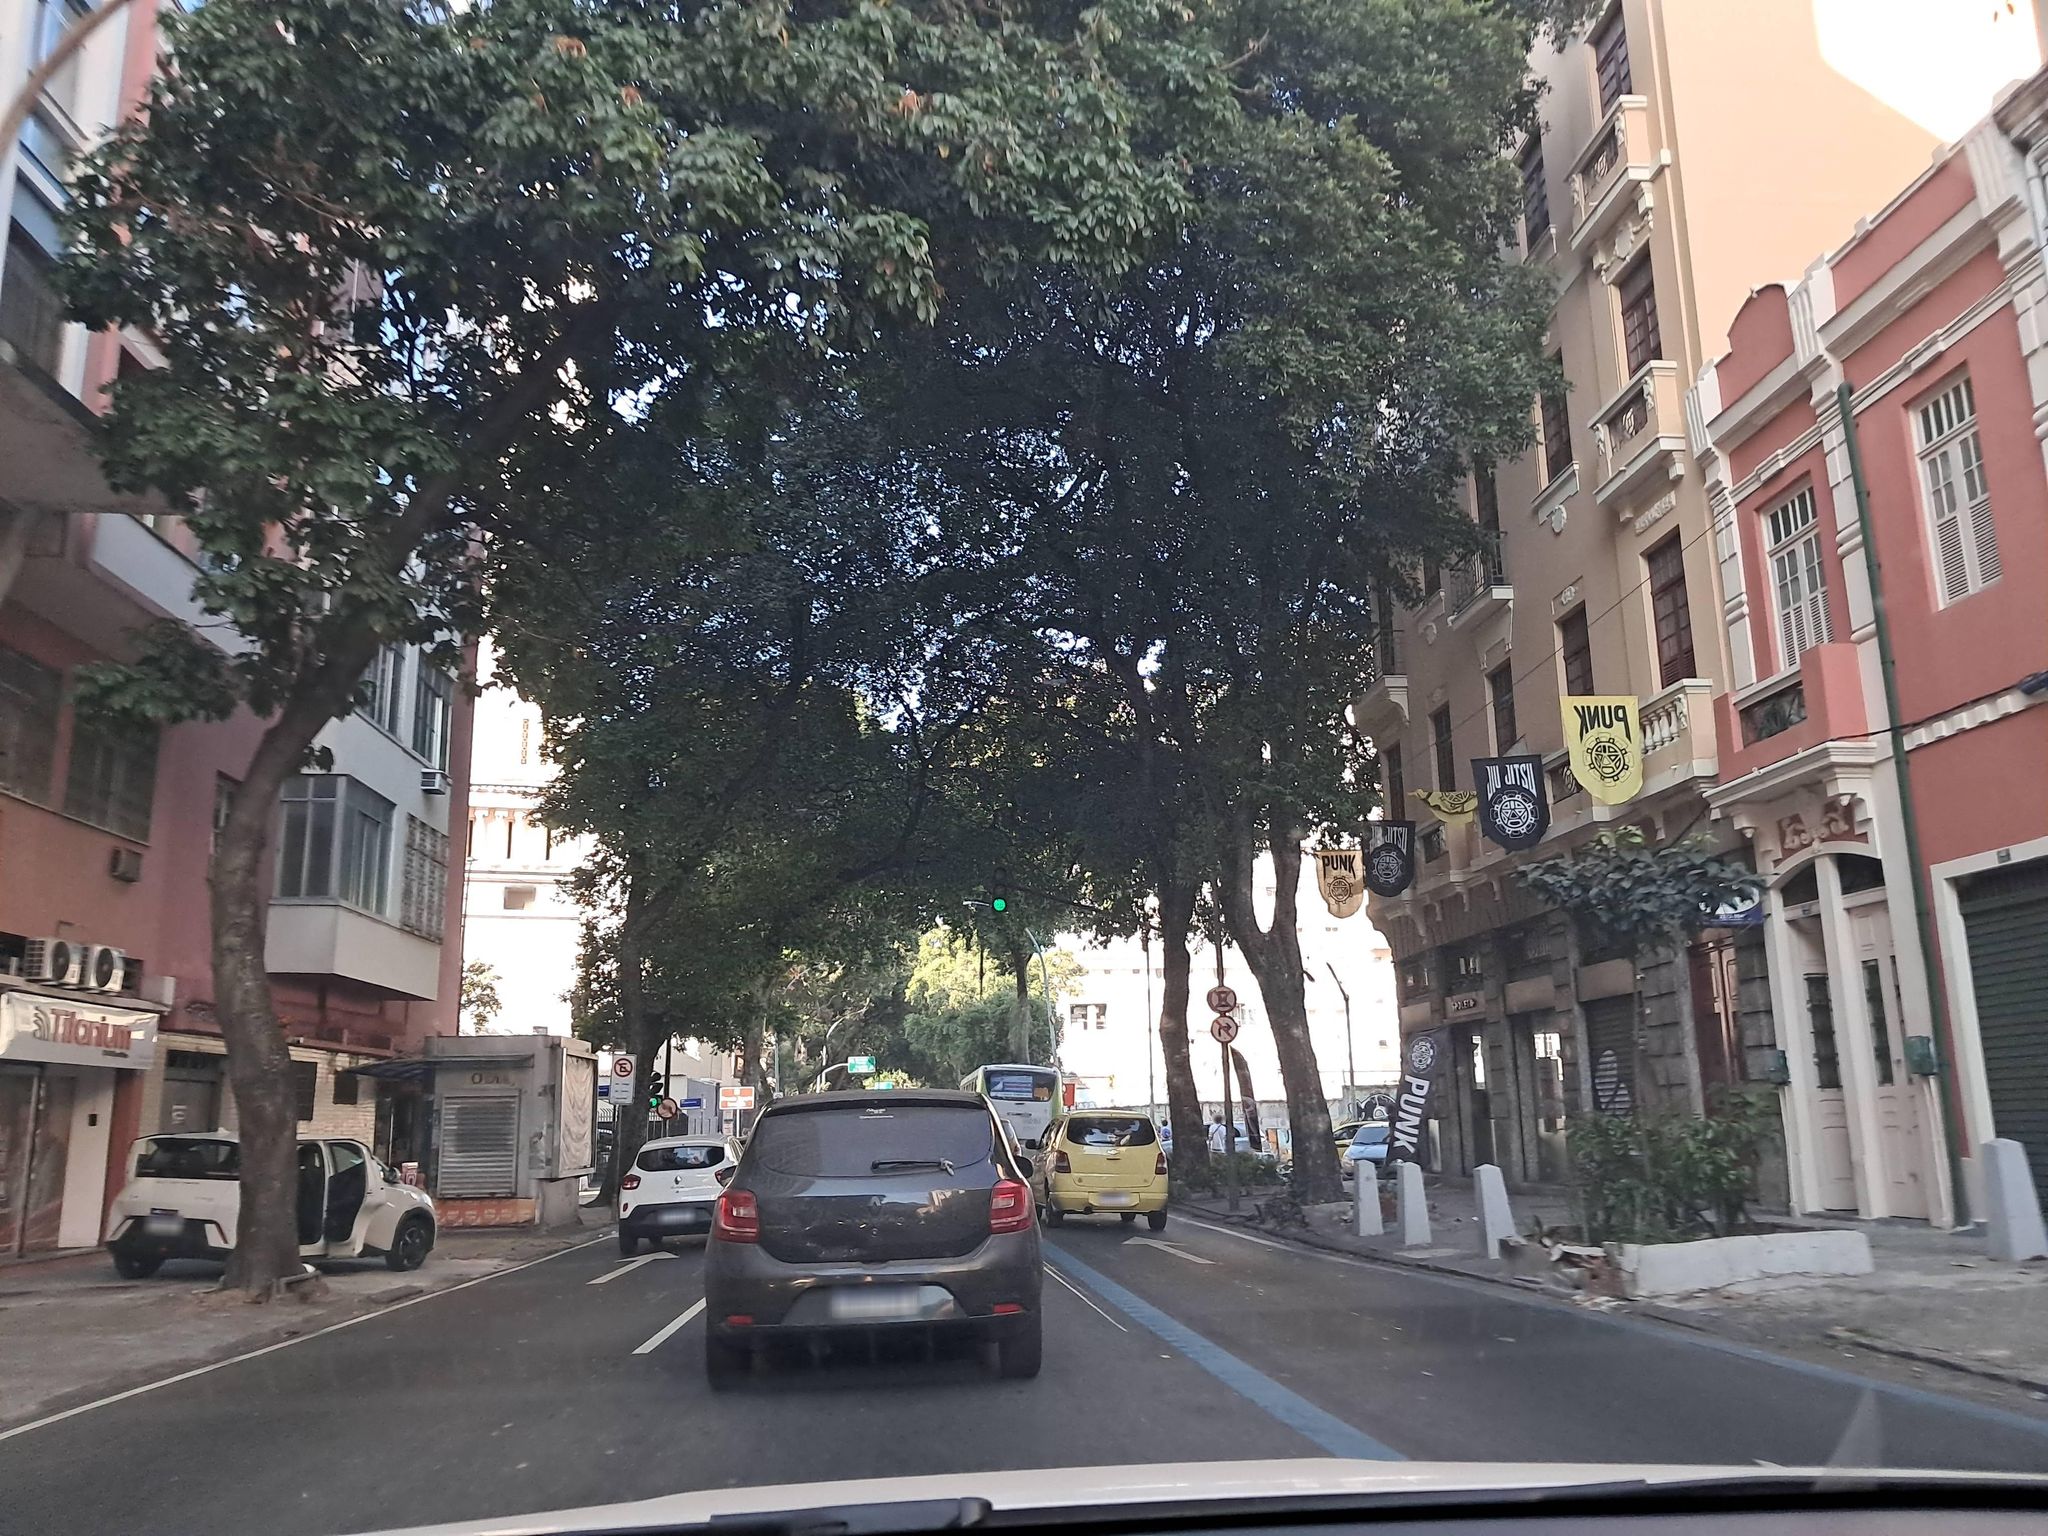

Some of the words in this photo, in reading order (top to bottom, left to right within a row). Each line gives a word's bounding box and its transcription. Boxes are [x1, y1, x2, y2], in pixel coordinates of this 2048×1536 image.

[1485, 765, 1502, 801] JIU
[1504, 763, 1538, 798] JITSU
[1385, 826, 1408, 856] JITSU
[1321, 854, 1357, 880] PUNK
[1393, 1074, 1430, 1154] PUNK
